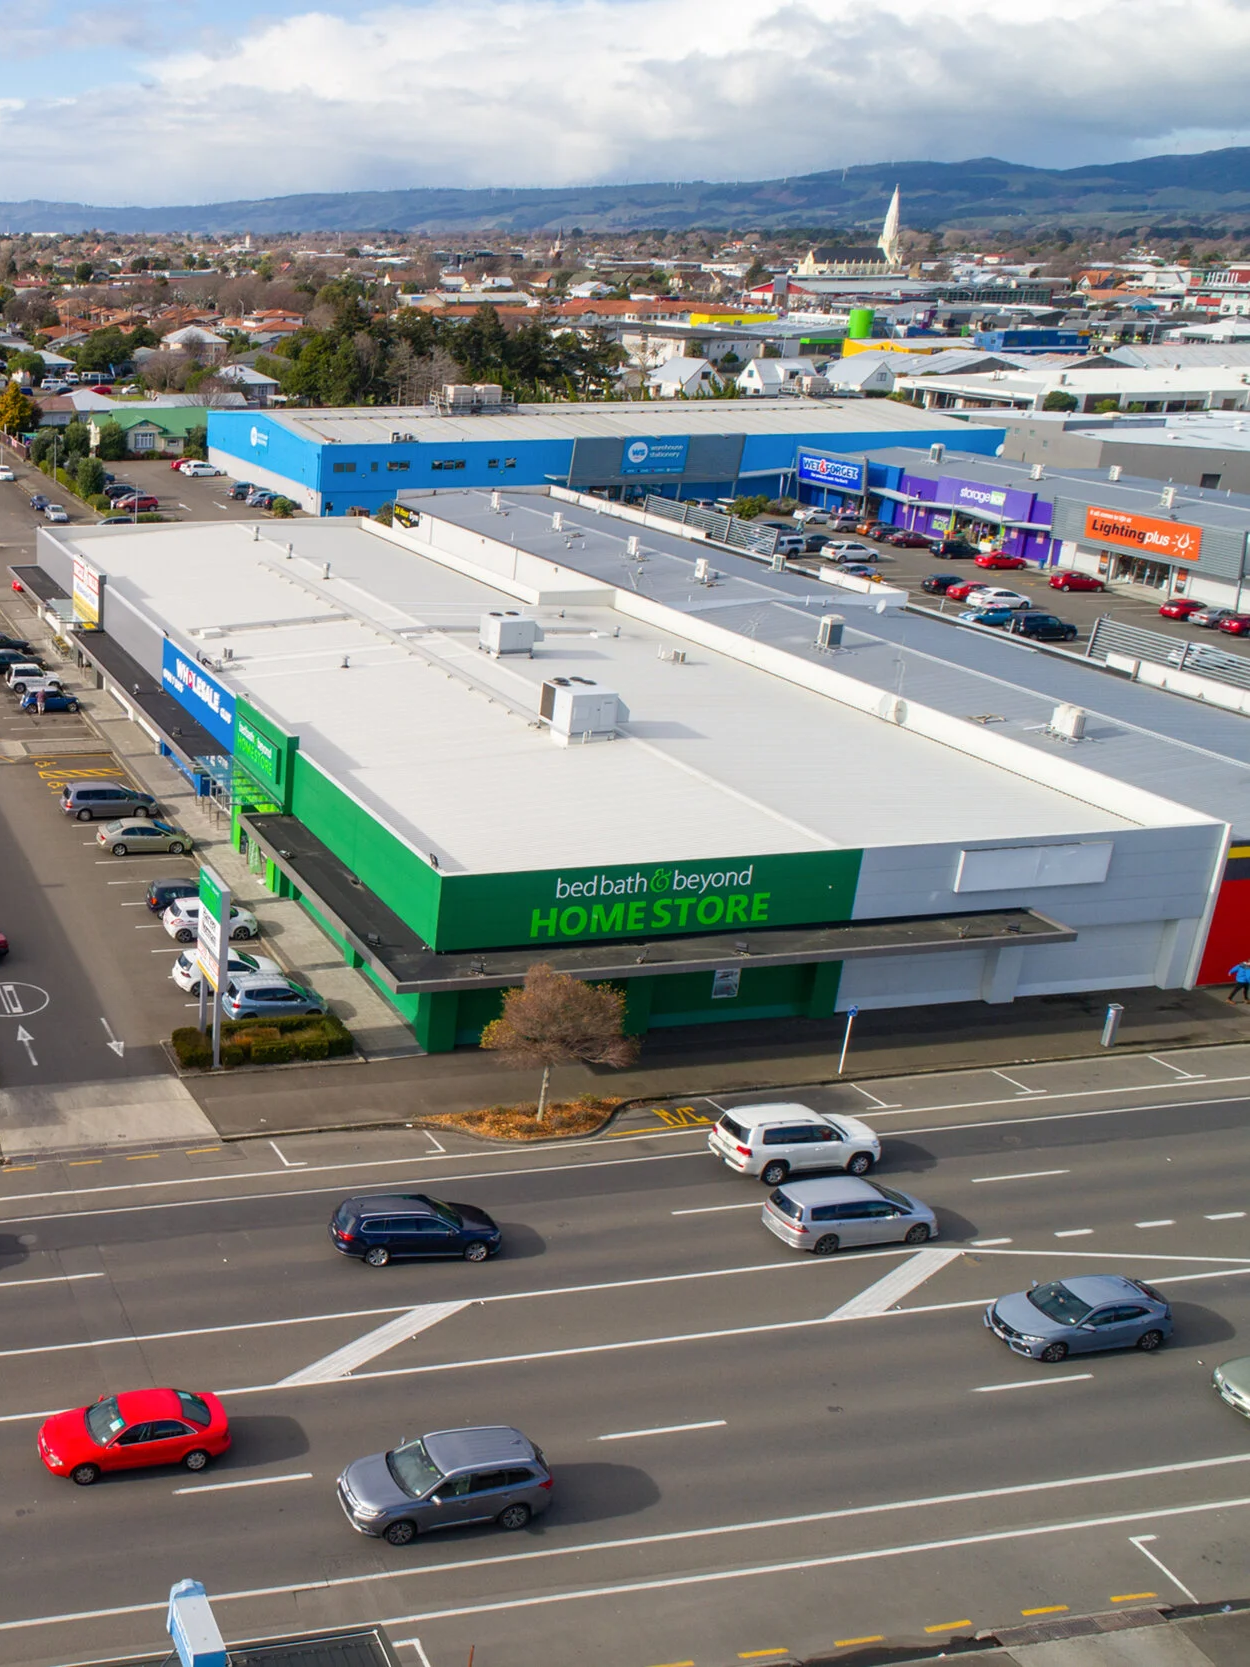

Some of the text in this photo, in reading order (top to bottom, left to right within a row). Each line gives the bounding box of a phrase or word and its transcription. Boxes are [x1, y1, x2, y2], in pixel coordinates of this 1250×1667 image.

[826, 462, 859, 480] FORGET
[960, 487, 991, 503] storage
[1092, 520, 1170, 546] Lighting plus
[650, 868, 672, 893] &
[672, 865, 754, 894] beyond
